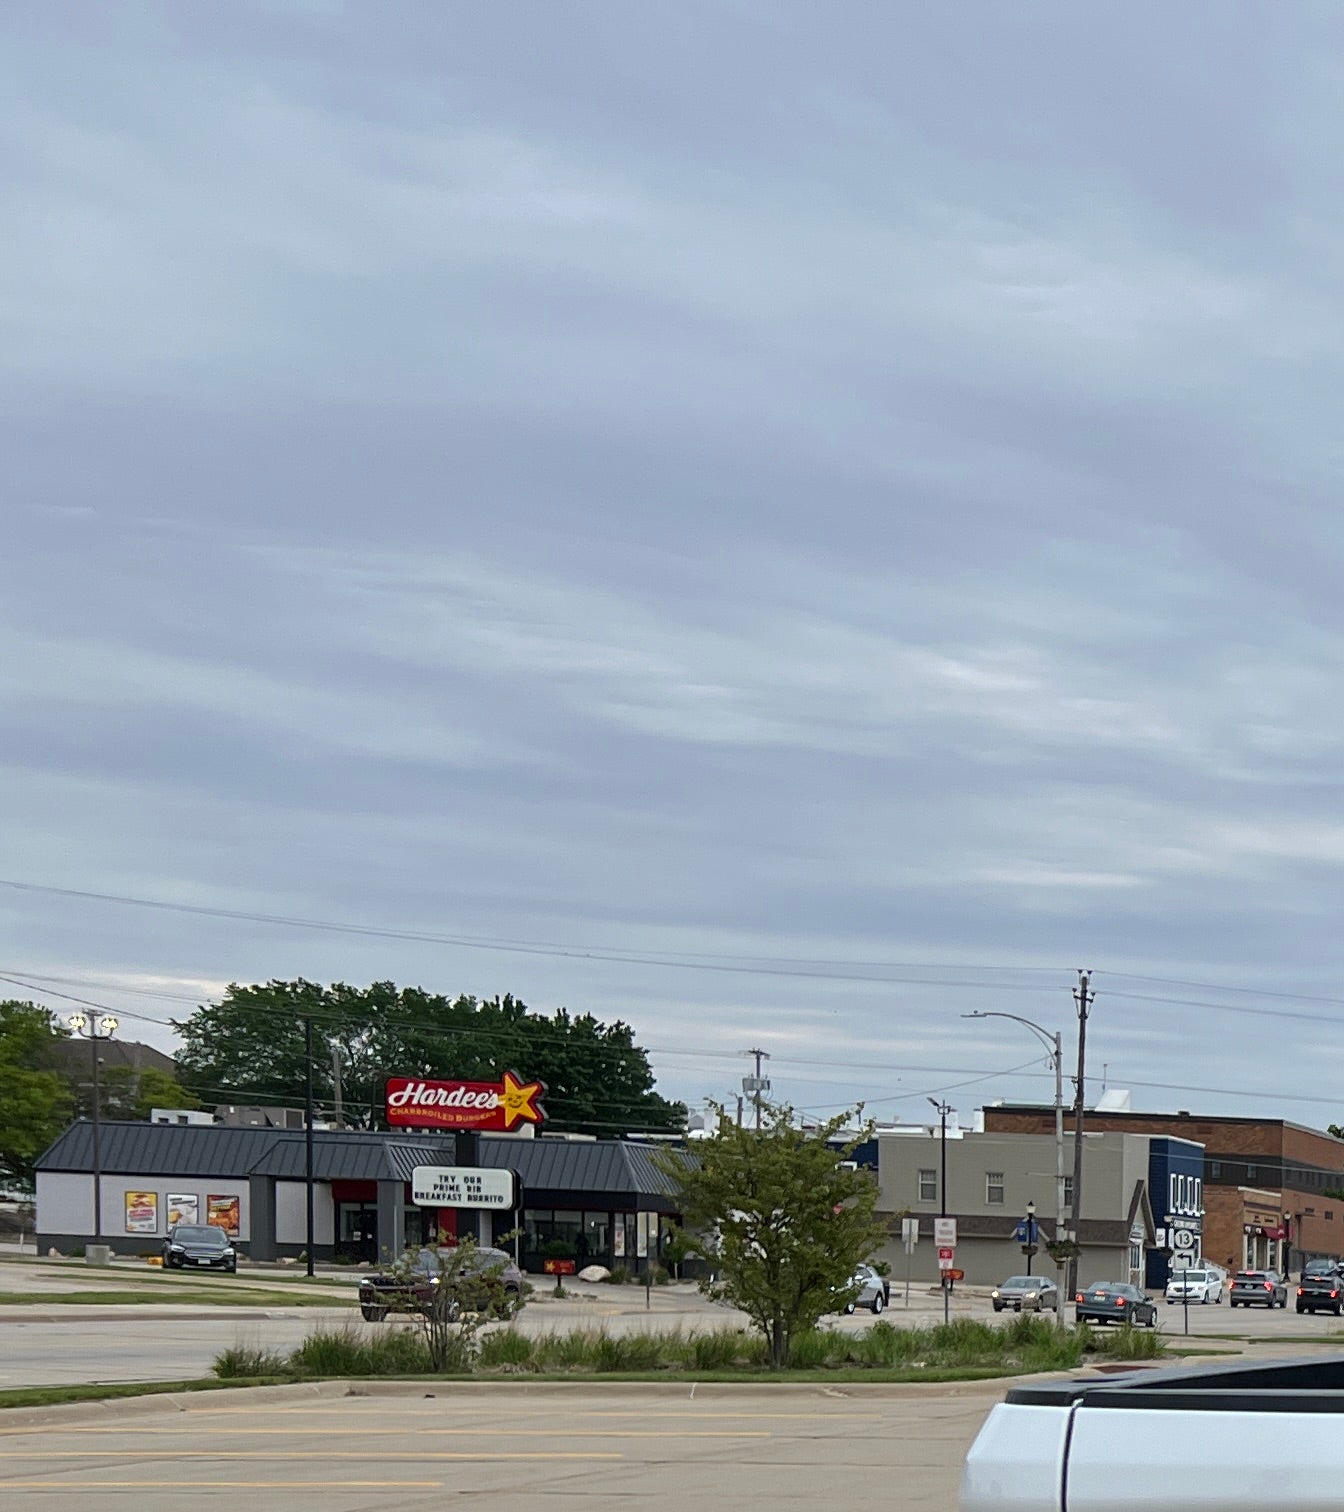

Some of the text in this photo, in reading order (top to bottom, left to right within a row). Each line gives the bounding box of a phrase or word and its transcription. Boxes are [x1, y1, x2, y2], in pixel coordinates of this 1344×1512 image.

[388, 1082, 498, 1109] Hardee's
[439, 1175, 482, 1185] TRY OUR
[433, 1184, 460, 1193] PRIME
[414, 1192, 504, 1204] BREAKFAST BURRITO
[1178, 1233, 1190, 1245] 13
